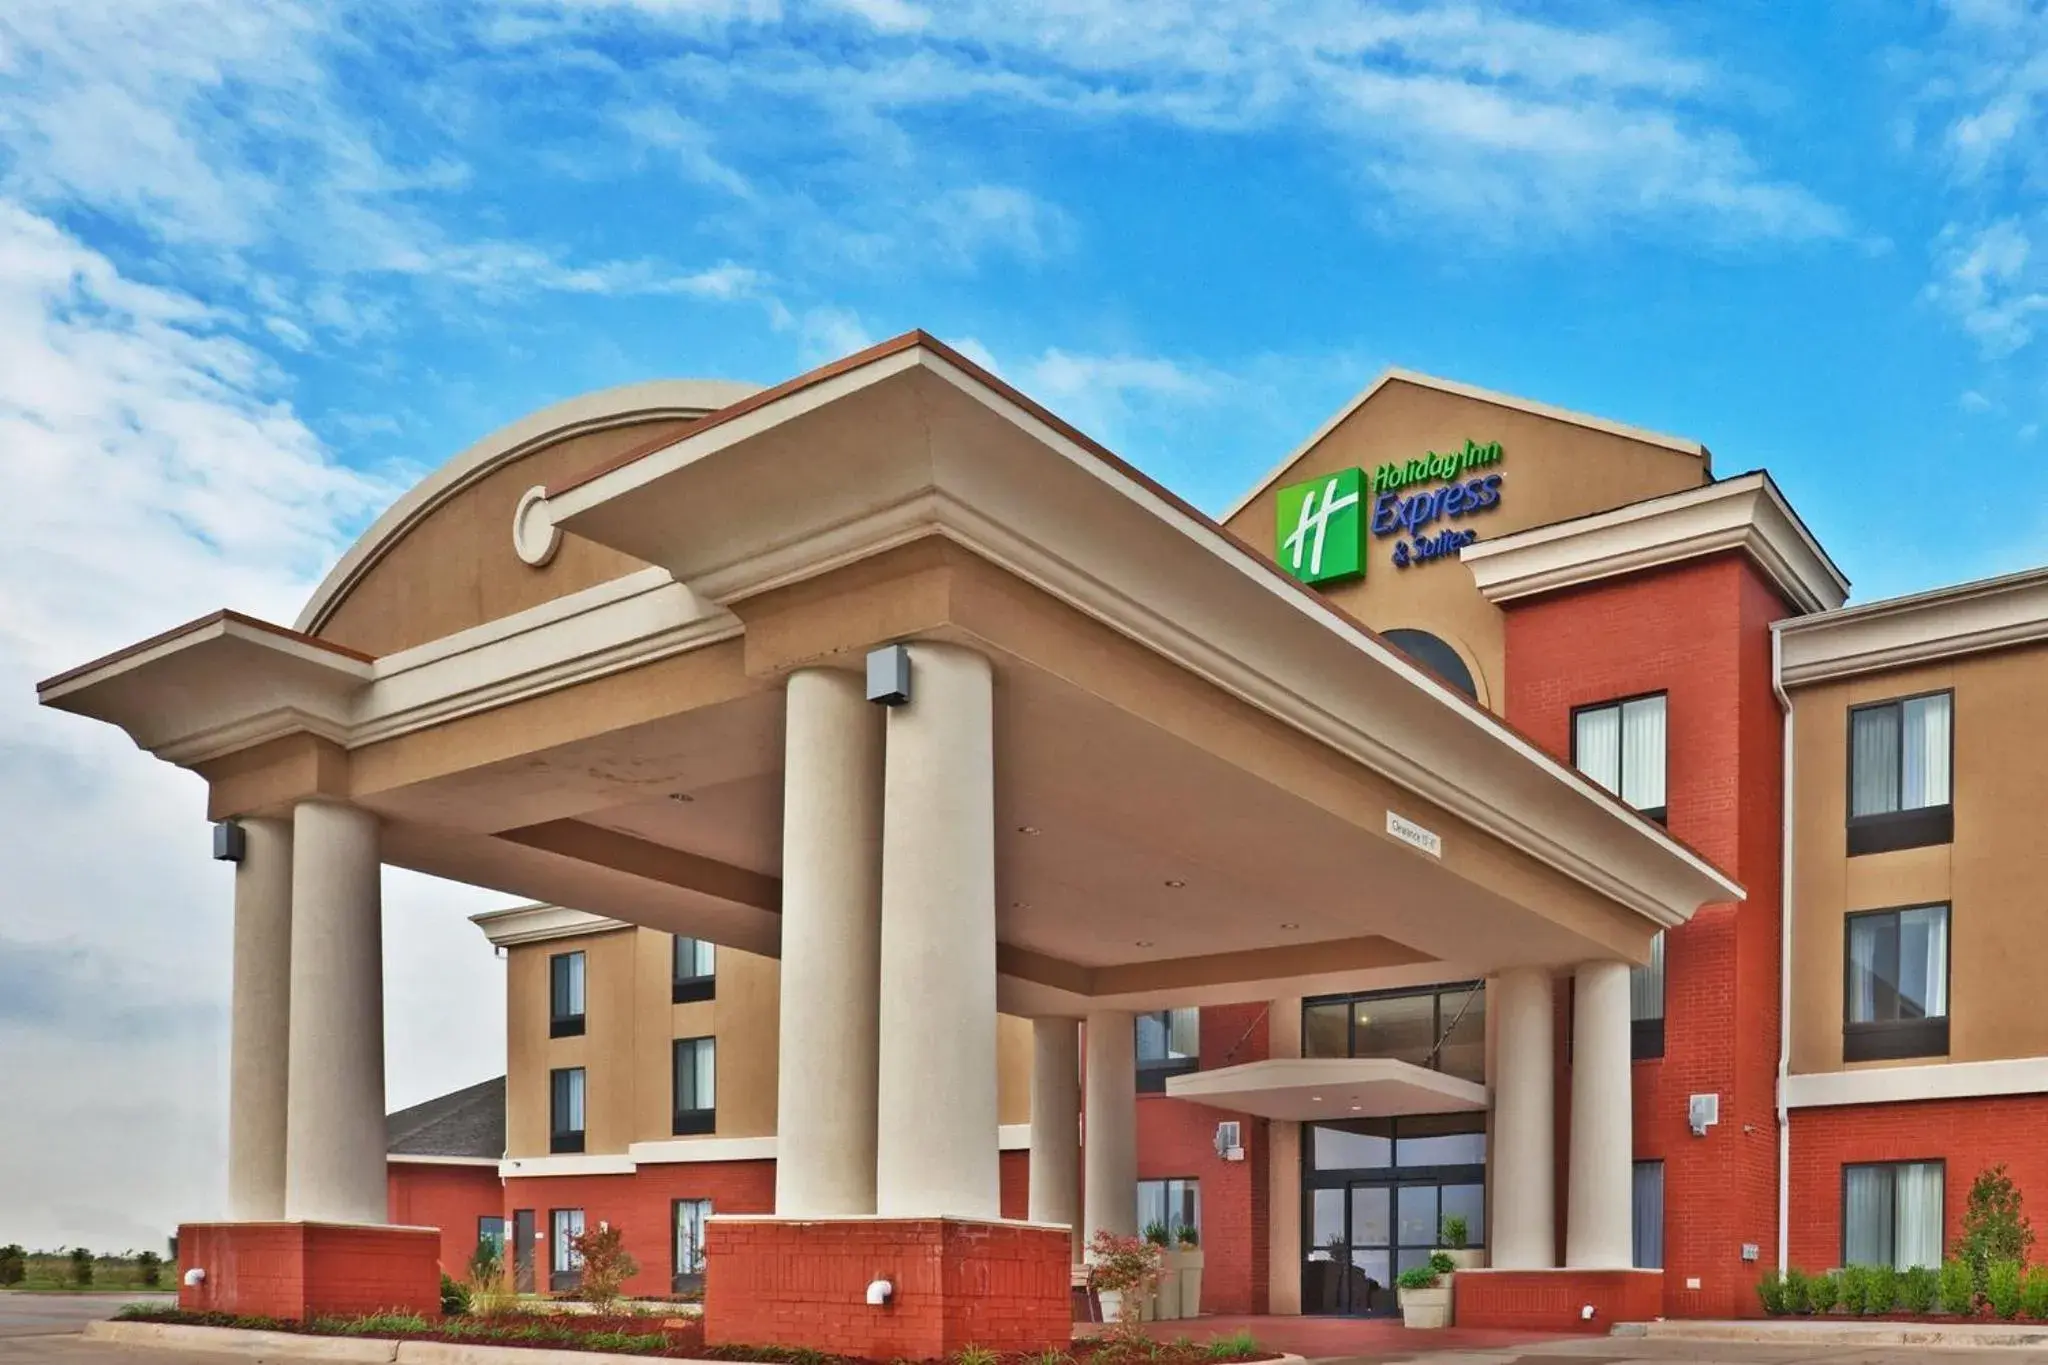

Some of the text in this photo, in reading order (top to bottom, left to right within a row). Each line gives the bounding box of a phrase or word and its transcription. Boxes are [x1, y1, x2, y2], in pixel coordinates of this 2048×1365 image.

[1373, 440, 1502, 494] Holiday Inn
[1371, 474, 1502, 538] Express
[1391, 529, 1477, 568] & Suites
